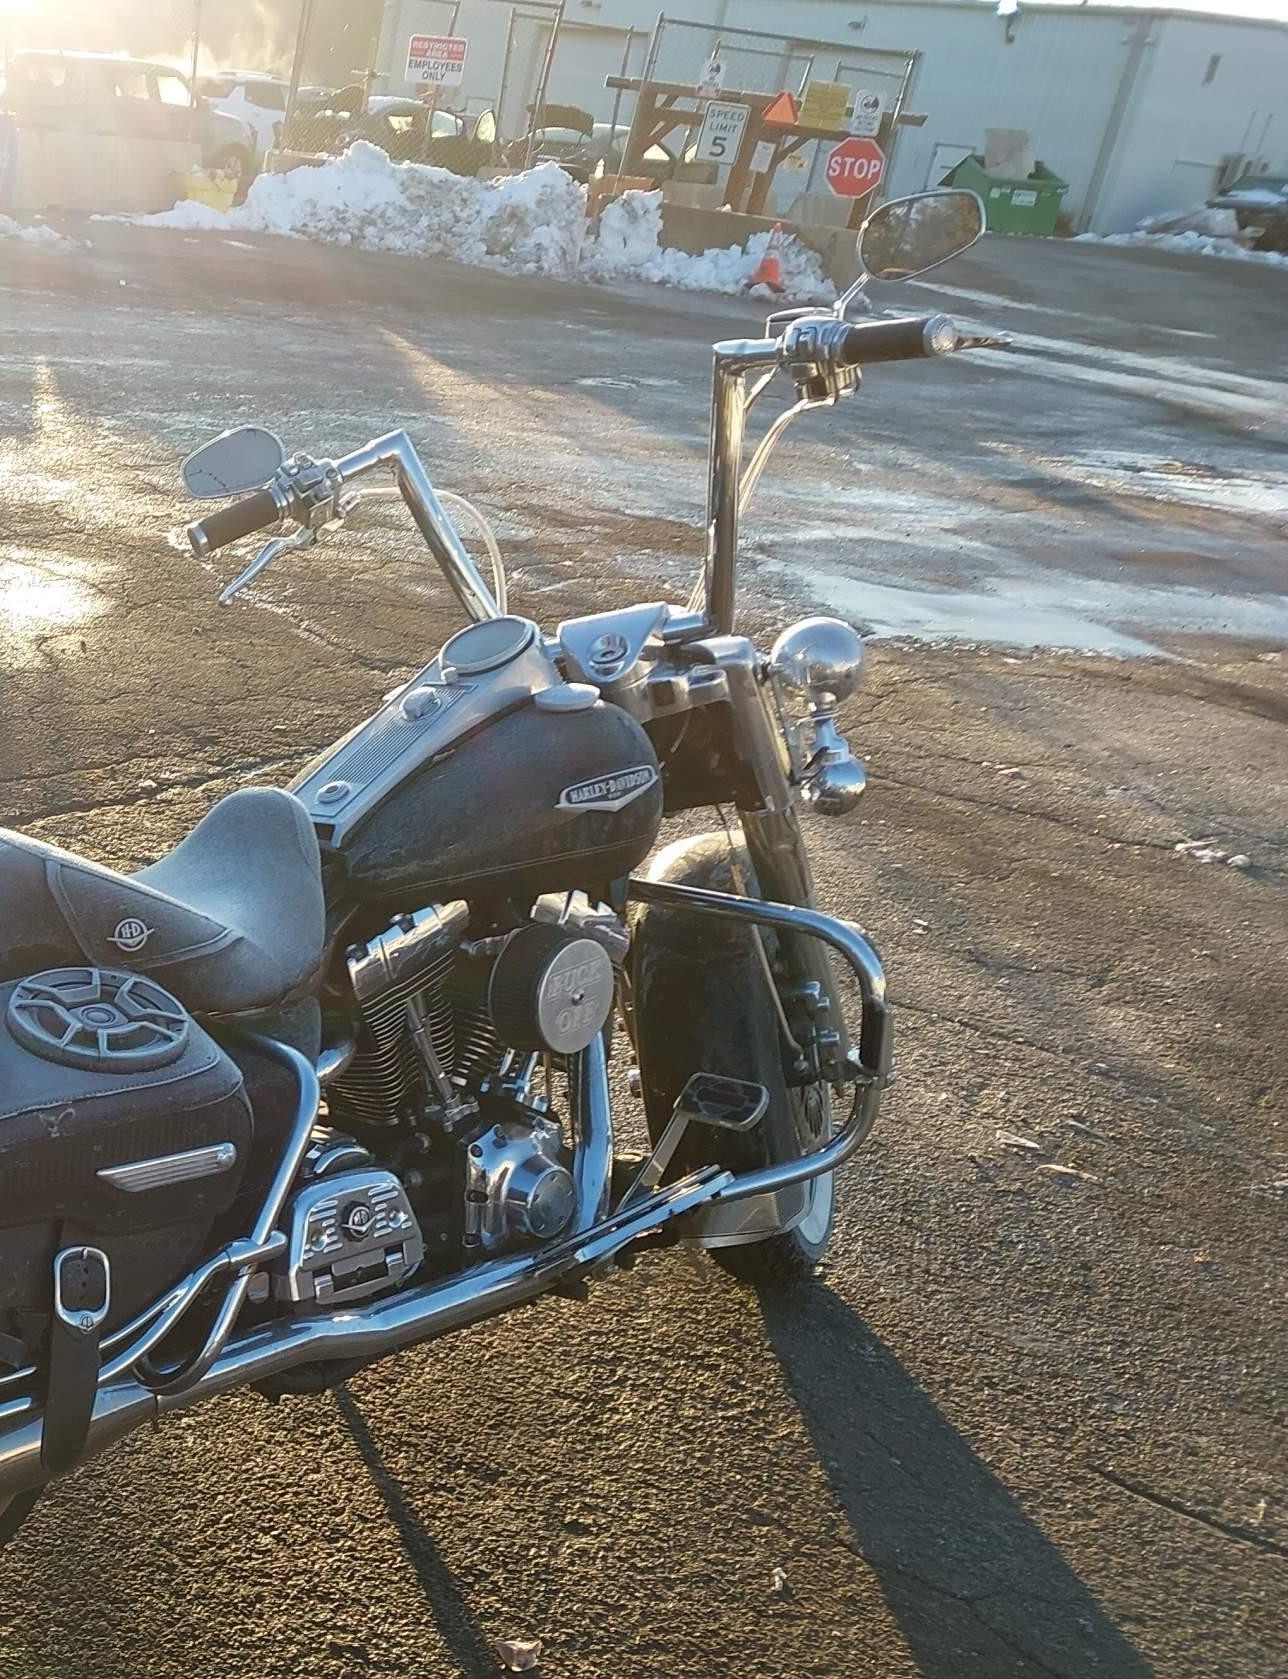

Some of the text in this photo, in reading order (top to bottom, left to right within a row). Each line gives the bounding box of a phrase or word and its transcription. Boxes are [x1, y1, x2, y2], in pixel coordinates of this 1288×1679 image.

[408, 59, 463, 73] EMPLOYEES
[422, 71, 446, 81] ONLY
[710, 109, 744, 122] SPEED
[709, 121, 738, 134] LIMIT
[709, 136, 727, 157] 5
[828, 156, 881, 179] STOP
[569, 769, 651, 803] HARLEY-DAVIDSON
